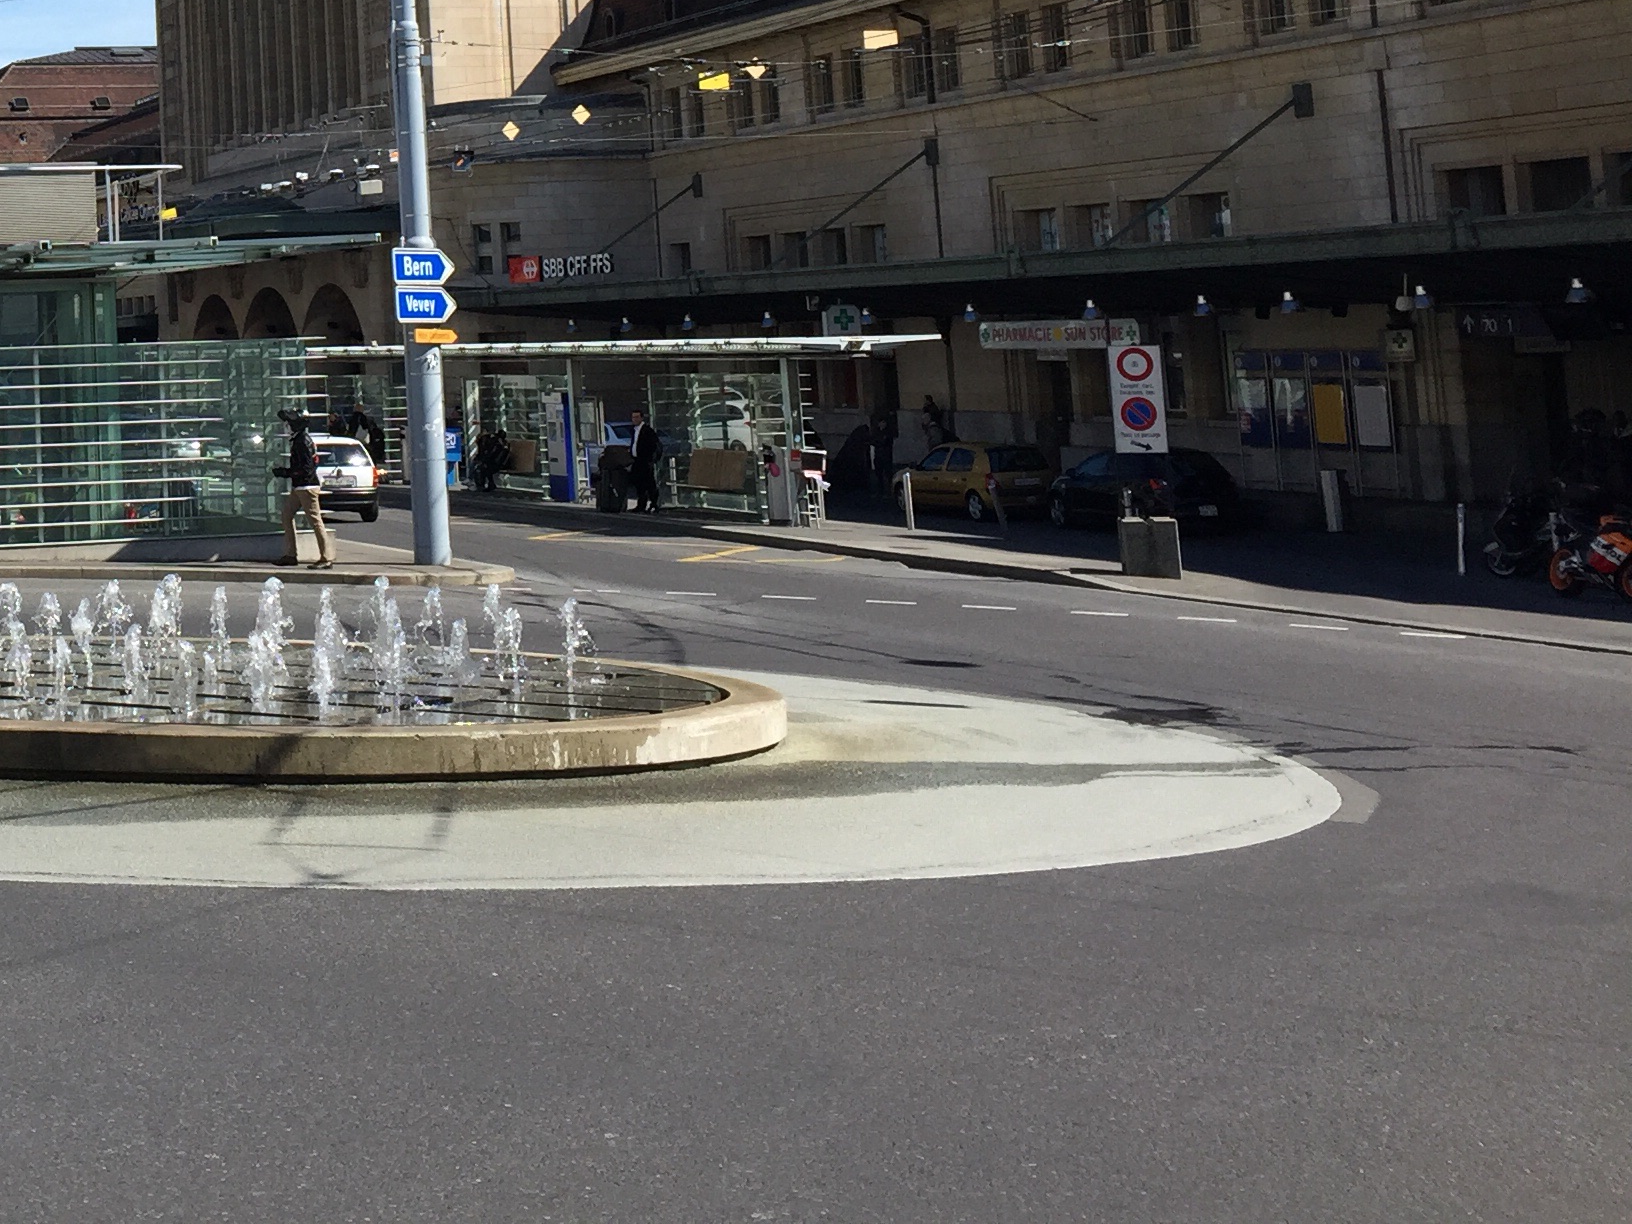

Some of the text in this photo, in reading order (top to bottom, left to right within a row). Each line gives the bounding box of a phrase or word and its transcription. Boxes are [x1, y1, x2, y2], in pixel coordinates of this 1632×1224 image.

[403, 255, 433, 276] Bern
[542, 252, 611, 278] SBB CFF FFS
[405, 294, 435, 316] Vevey
[991, 326, 1124, 343] PHARMACIE SUN STORE
